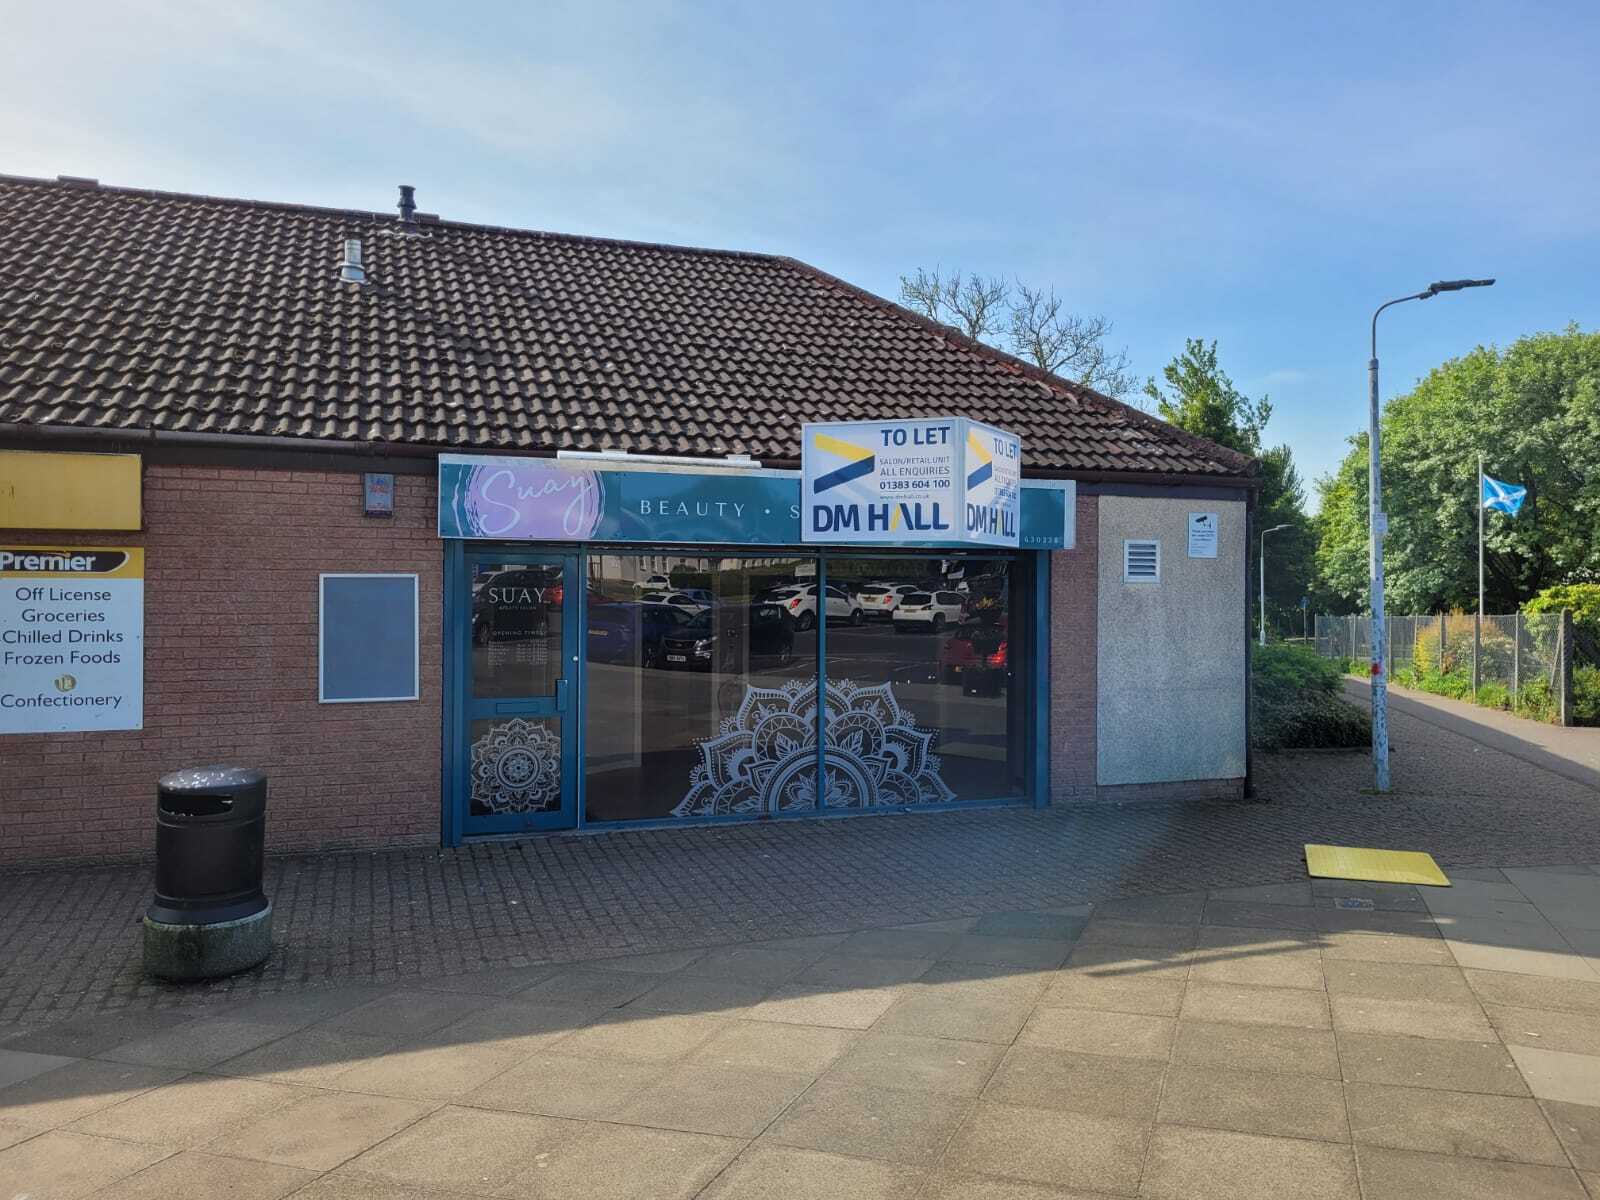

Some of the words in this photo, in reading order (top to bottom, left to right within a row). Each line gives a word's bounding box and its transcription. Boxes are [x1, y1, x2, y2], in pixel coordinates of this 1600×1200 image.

[881, 428, 907, 446] TO
[914, 426, 951, 445] LET
[993, 438, 1004, 456] TO
[880, 467, 897, 477] ALL
[899, 466, 950, 477] ENQUIRIES
[880, 480, 910, 490] 01383
[911, 479, 930, 489] 604
[932, 479, 951, 489] 100
[479, 469, 594, 537] Suay
[639, 499, 746, 518] BEAUTY
[812, 503, 861, 533] DM
[867, 502, 951, 533] HALL
[967, 503, 987, 533] DM
[0, 551, 97, 571] Premier
[15, 587, 45, 601] Off
[49, 587, 112, 601] License
[488, 586, 546, 605] SUAY
[21, 608, 106, 623] Groceries
[2, 629, 62, 644] Chilled
[68, 629, 124, 643] Drinks
[4, 651, 64, 665] Frozen
[70, 650, 121, 664] Foods
[0, 693, 122, 709] Confectionery
